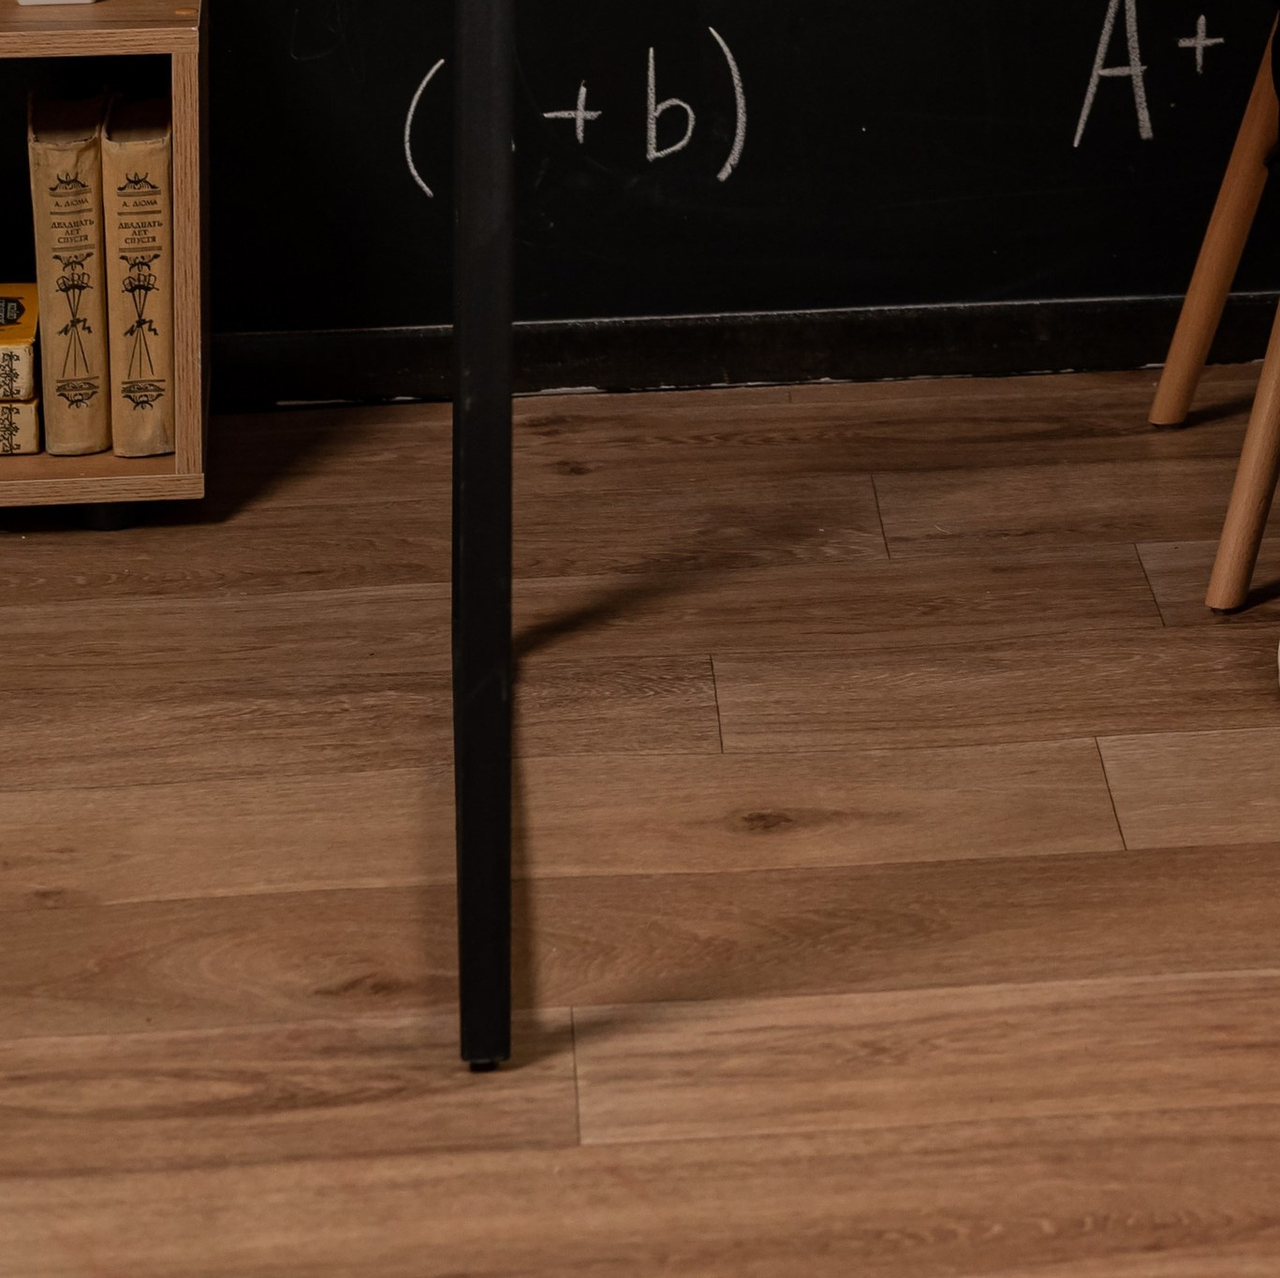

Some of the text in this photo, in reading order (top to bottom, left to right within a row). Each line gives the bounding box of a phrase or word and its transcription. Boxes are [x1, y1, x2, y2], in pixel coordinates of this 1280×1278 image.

[51, 219, 94, 229] ДВАДЦАТЬ
[118, 221, 163, 230] ДВАДЦАТЬ
[65, 228, 81, 236] ЛЕТ
[58, 234, 89, 244] СПУСТЯ
[124, 236, 156, 244] СПУСТЯ
